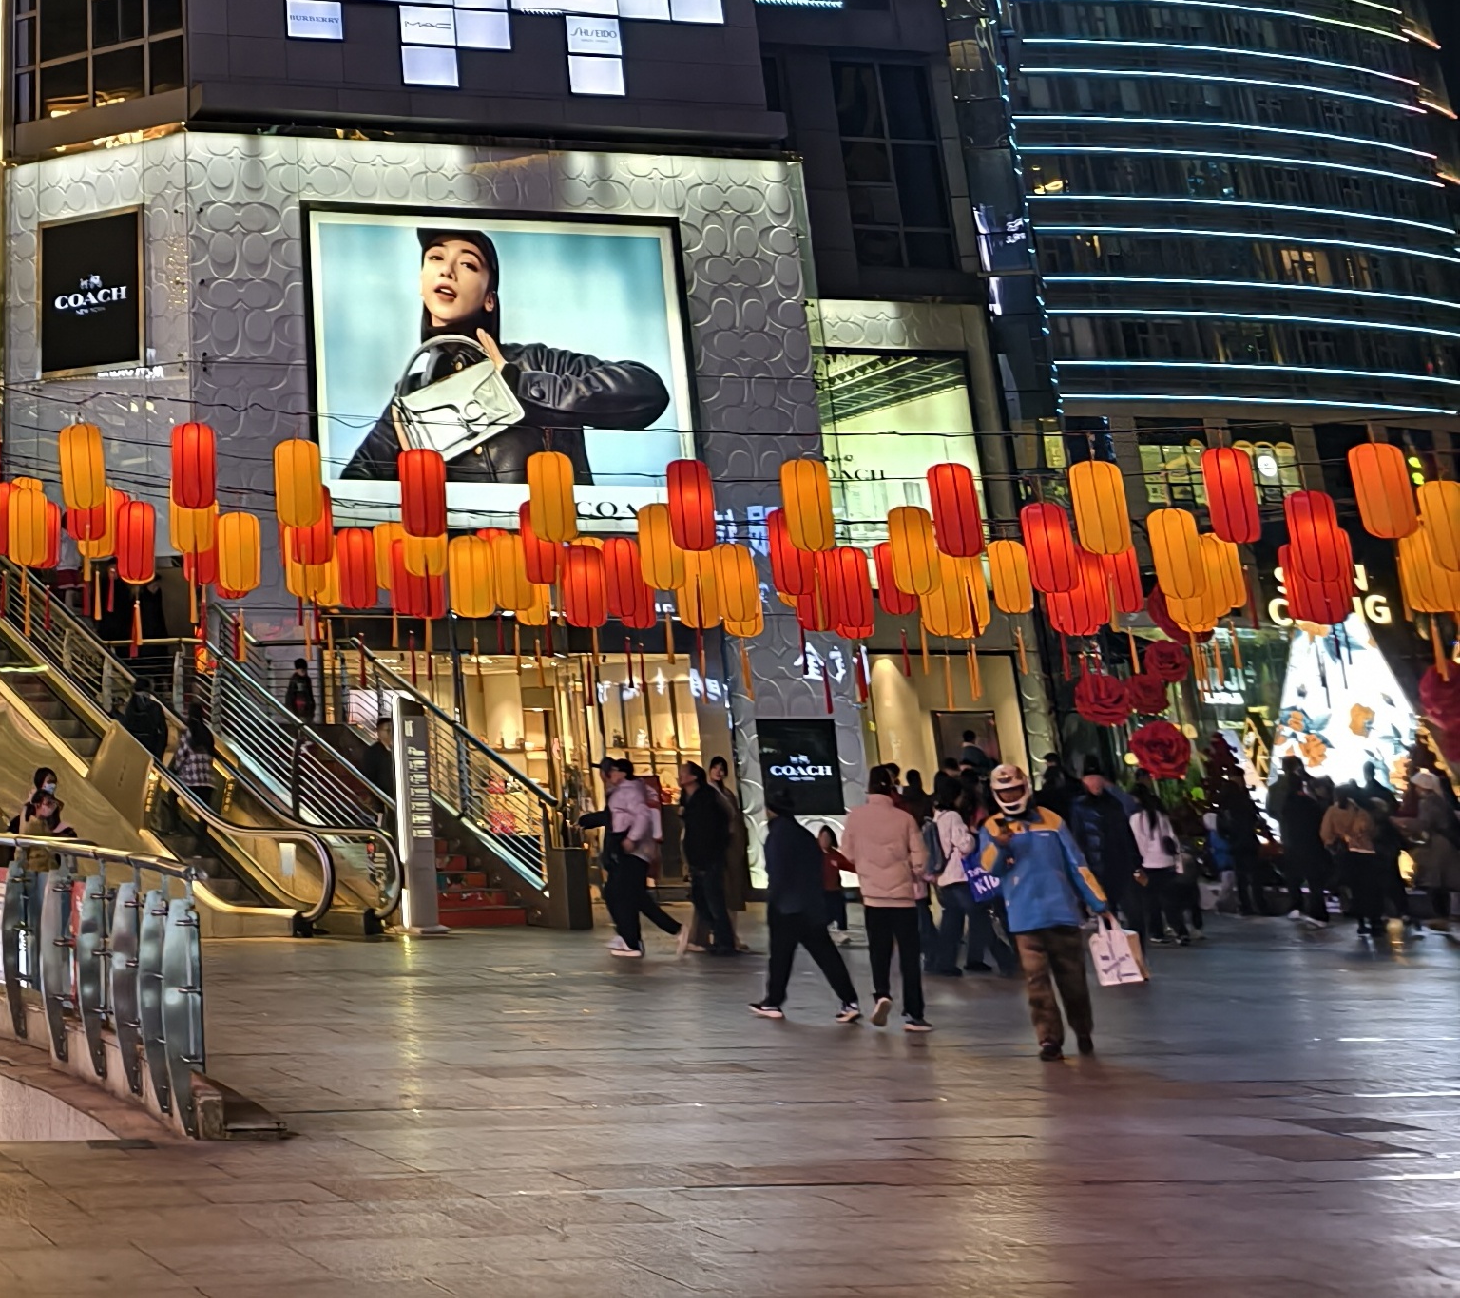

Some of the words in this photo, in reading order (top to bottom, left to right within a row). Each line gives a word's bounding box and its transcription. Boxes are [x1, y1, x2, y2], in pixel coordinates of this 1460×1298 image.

[289, 14, 340, 24] BURBERRY
[54, 285, 127, 310] COACH
[769, 764, 833, 777] COACH
